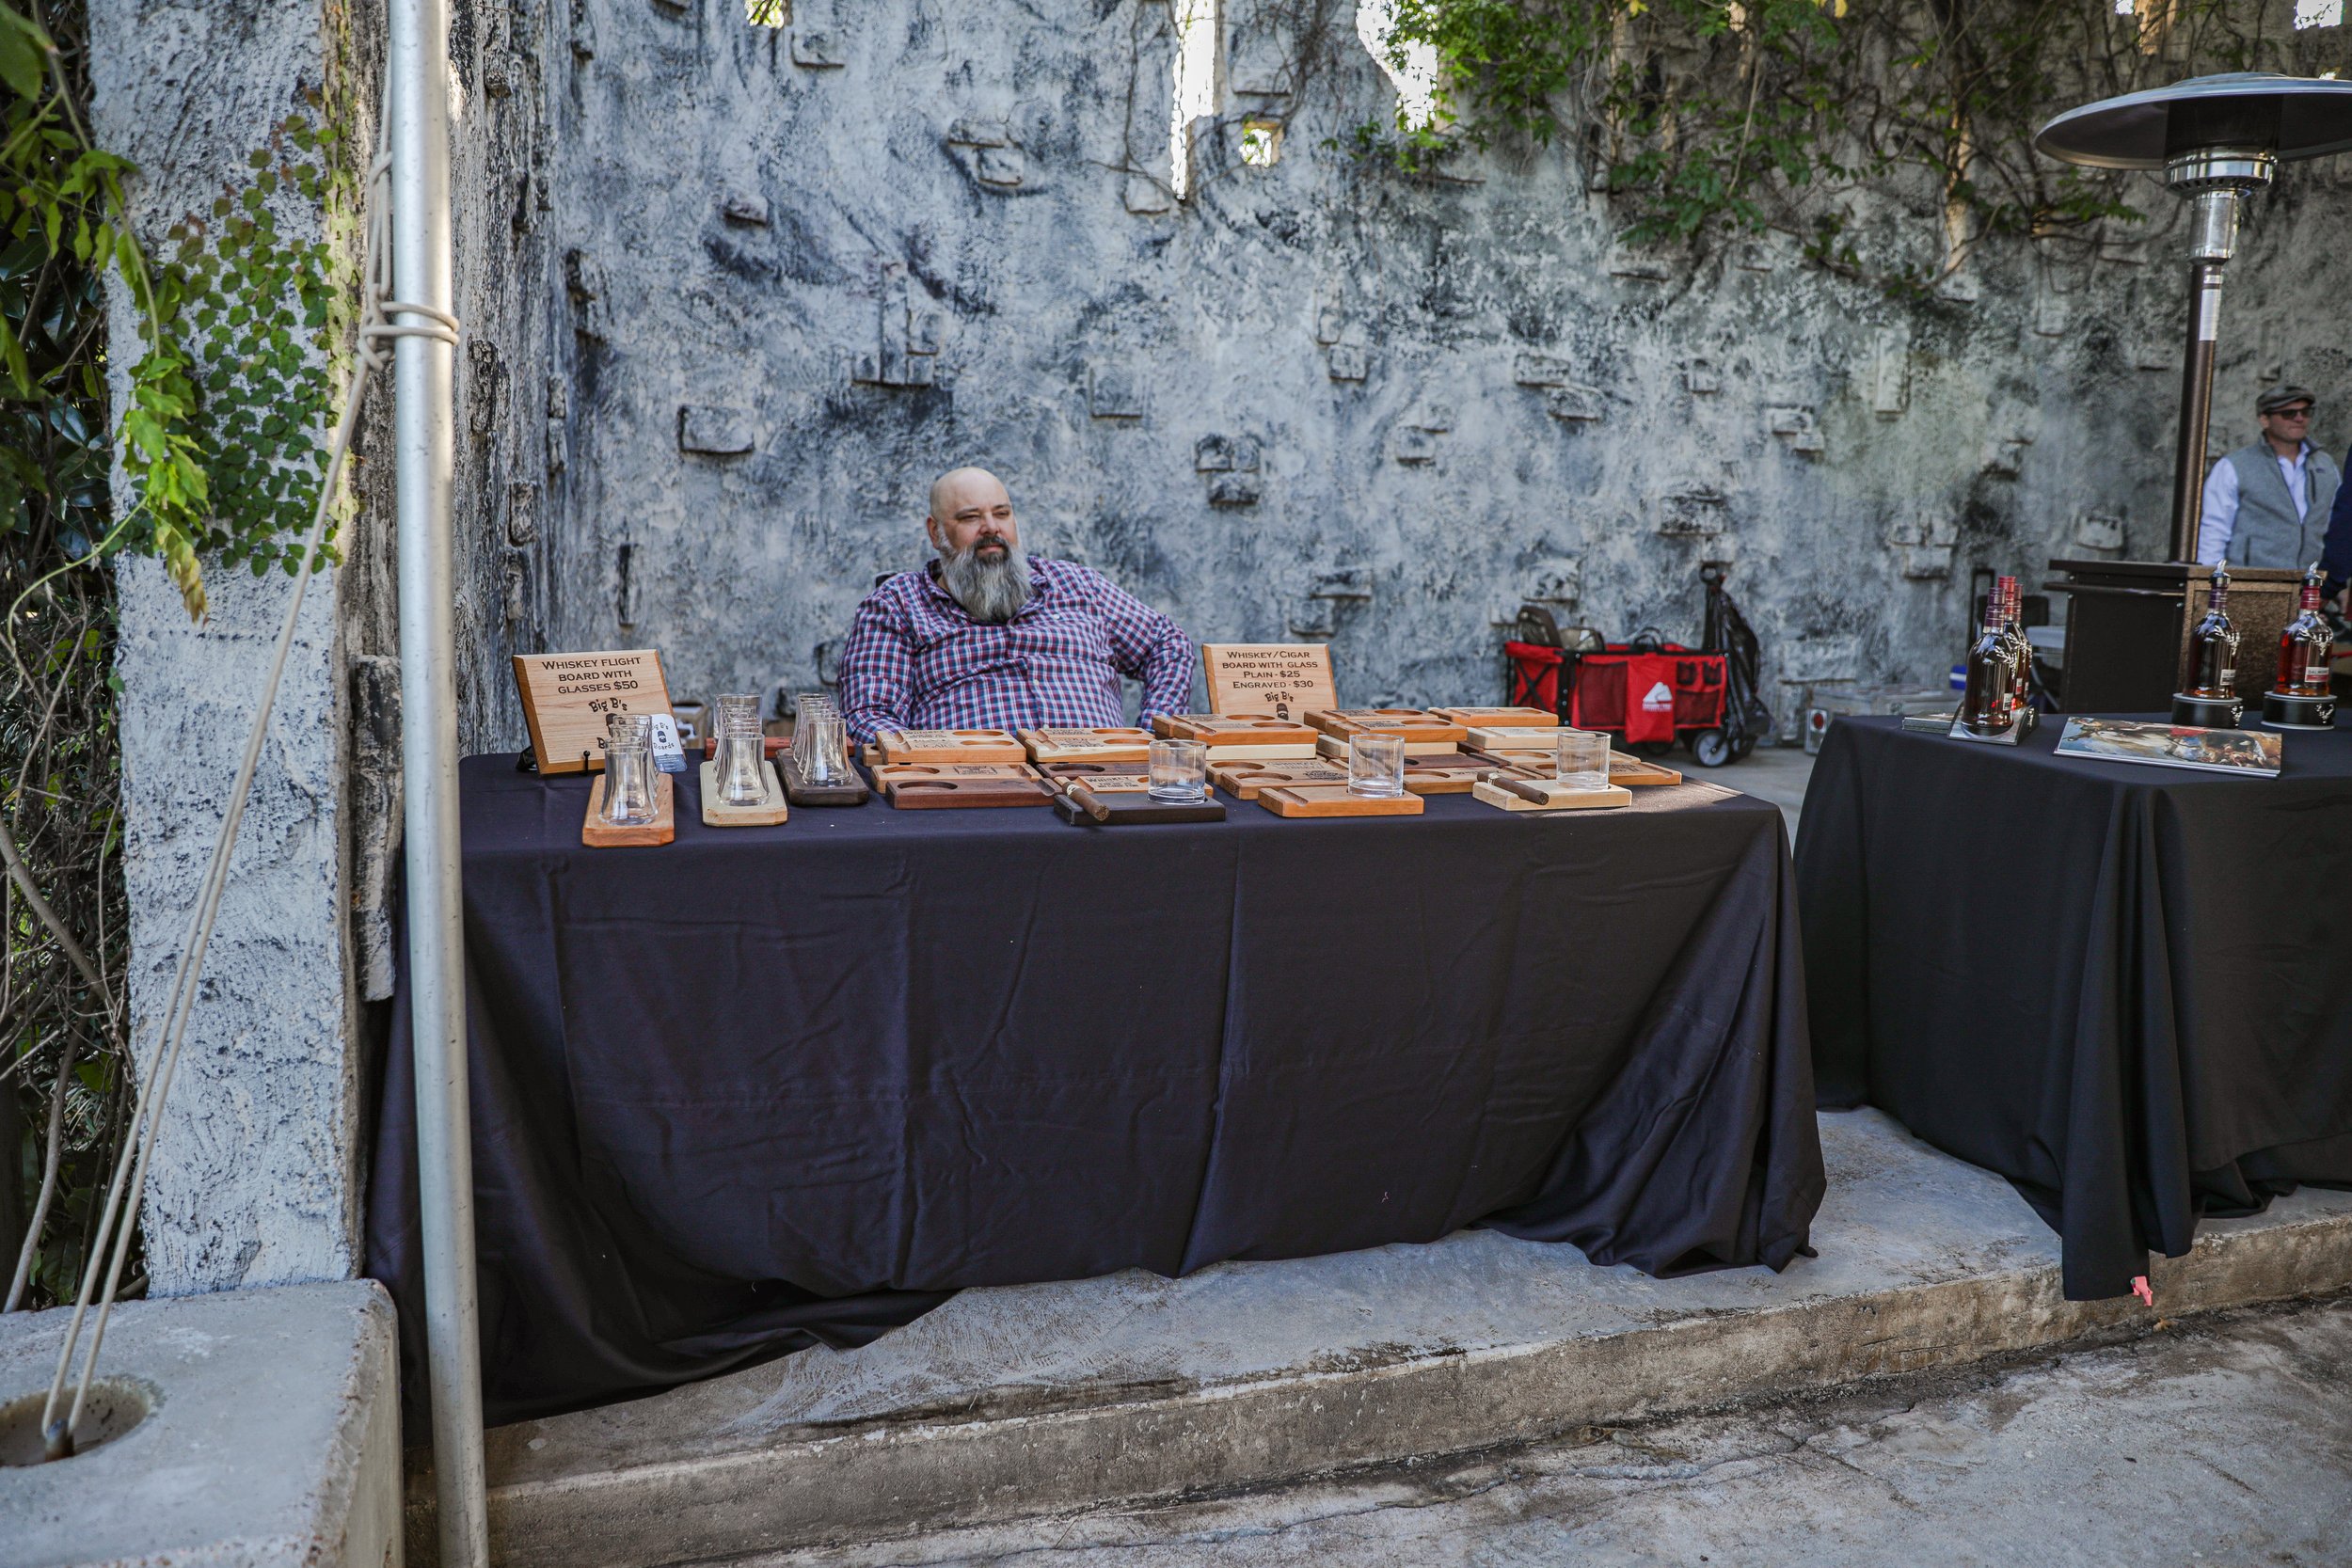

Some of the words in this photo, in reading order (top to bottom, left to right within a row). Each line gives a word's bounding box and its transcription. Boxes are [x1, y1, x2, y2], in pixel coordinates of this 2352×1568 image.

[1227, 650, 1311, 659] WHISKEY/CIGAR
[542, 659, 597, 671] WHISKEY
[601, 657, 641, 667] FLIGHT
[558, 672, 600, 682] BOARD
[602, 670, 632, 679] WITH
[1279, 670, 1300, 678] $25
[558, 683, 612, 694] GLASSES
[613, 680, 639, 690] $50
[1293, 680, 1314, 689] $30
[1264, 692, 1279, 703] Big
[1280, 691, 1295, 703] B's
[588, 699, 609, 712] Big
[610, 697, 628, 711] B's
